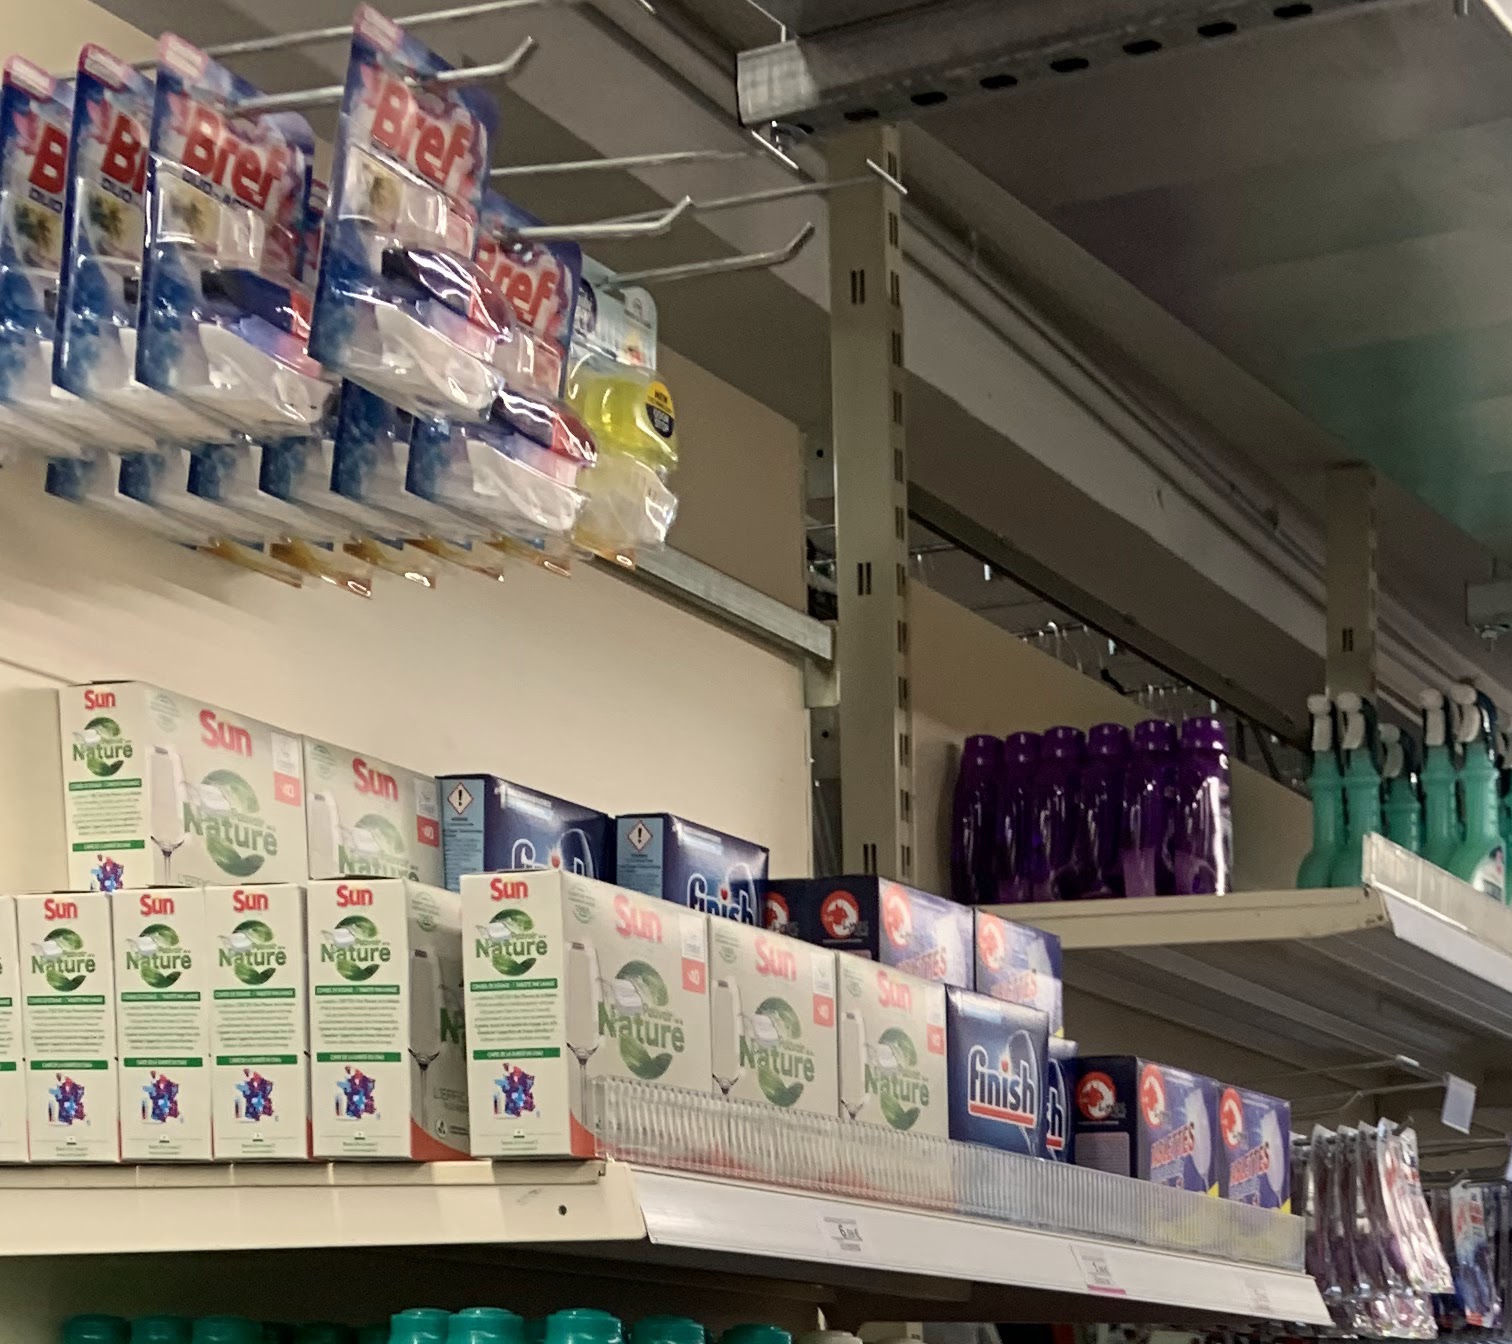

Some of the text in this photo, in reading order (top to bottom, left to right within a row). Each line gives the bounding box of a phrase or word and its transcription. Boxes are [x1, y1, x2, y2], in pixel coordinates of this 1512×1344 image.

[372, 78, 474, 185] Bref
[182, 103, 291, 211] Bref
[84, 690, 116, 711] Sun
[199, 708, 253, 757] Sun
[72, 742, 133, 761] Nature
[352, 758, 399, 801] Sun
[183, 801, 277, 856] Nature
[139, 893, 175, 916] Sun
[232, 889, 269, 913] Sun
[336, 884, 374, 907] Sun
[489, 877, 528, 902] Sun
[44, 898, 78, 920] Sun
[613, 894, 663, 943] Sun
[125, 951, 192, 970] Nature
[218, 948, 287, 967] Nature
[320, 943, 391, 963] Nature
[475, 937, 548, 958] Nature
[754, 936, 797, 982] Sun
[31, 955, 96, 975] Nature
[876, 969, 912, 1010] Sun
[598, 1000, 685, 1053] Nature
[739, 1035, 815, 1082] Nature
[864, 1063, 929, 1107] Nature
[968, 1045, 1037, 1113] finish
